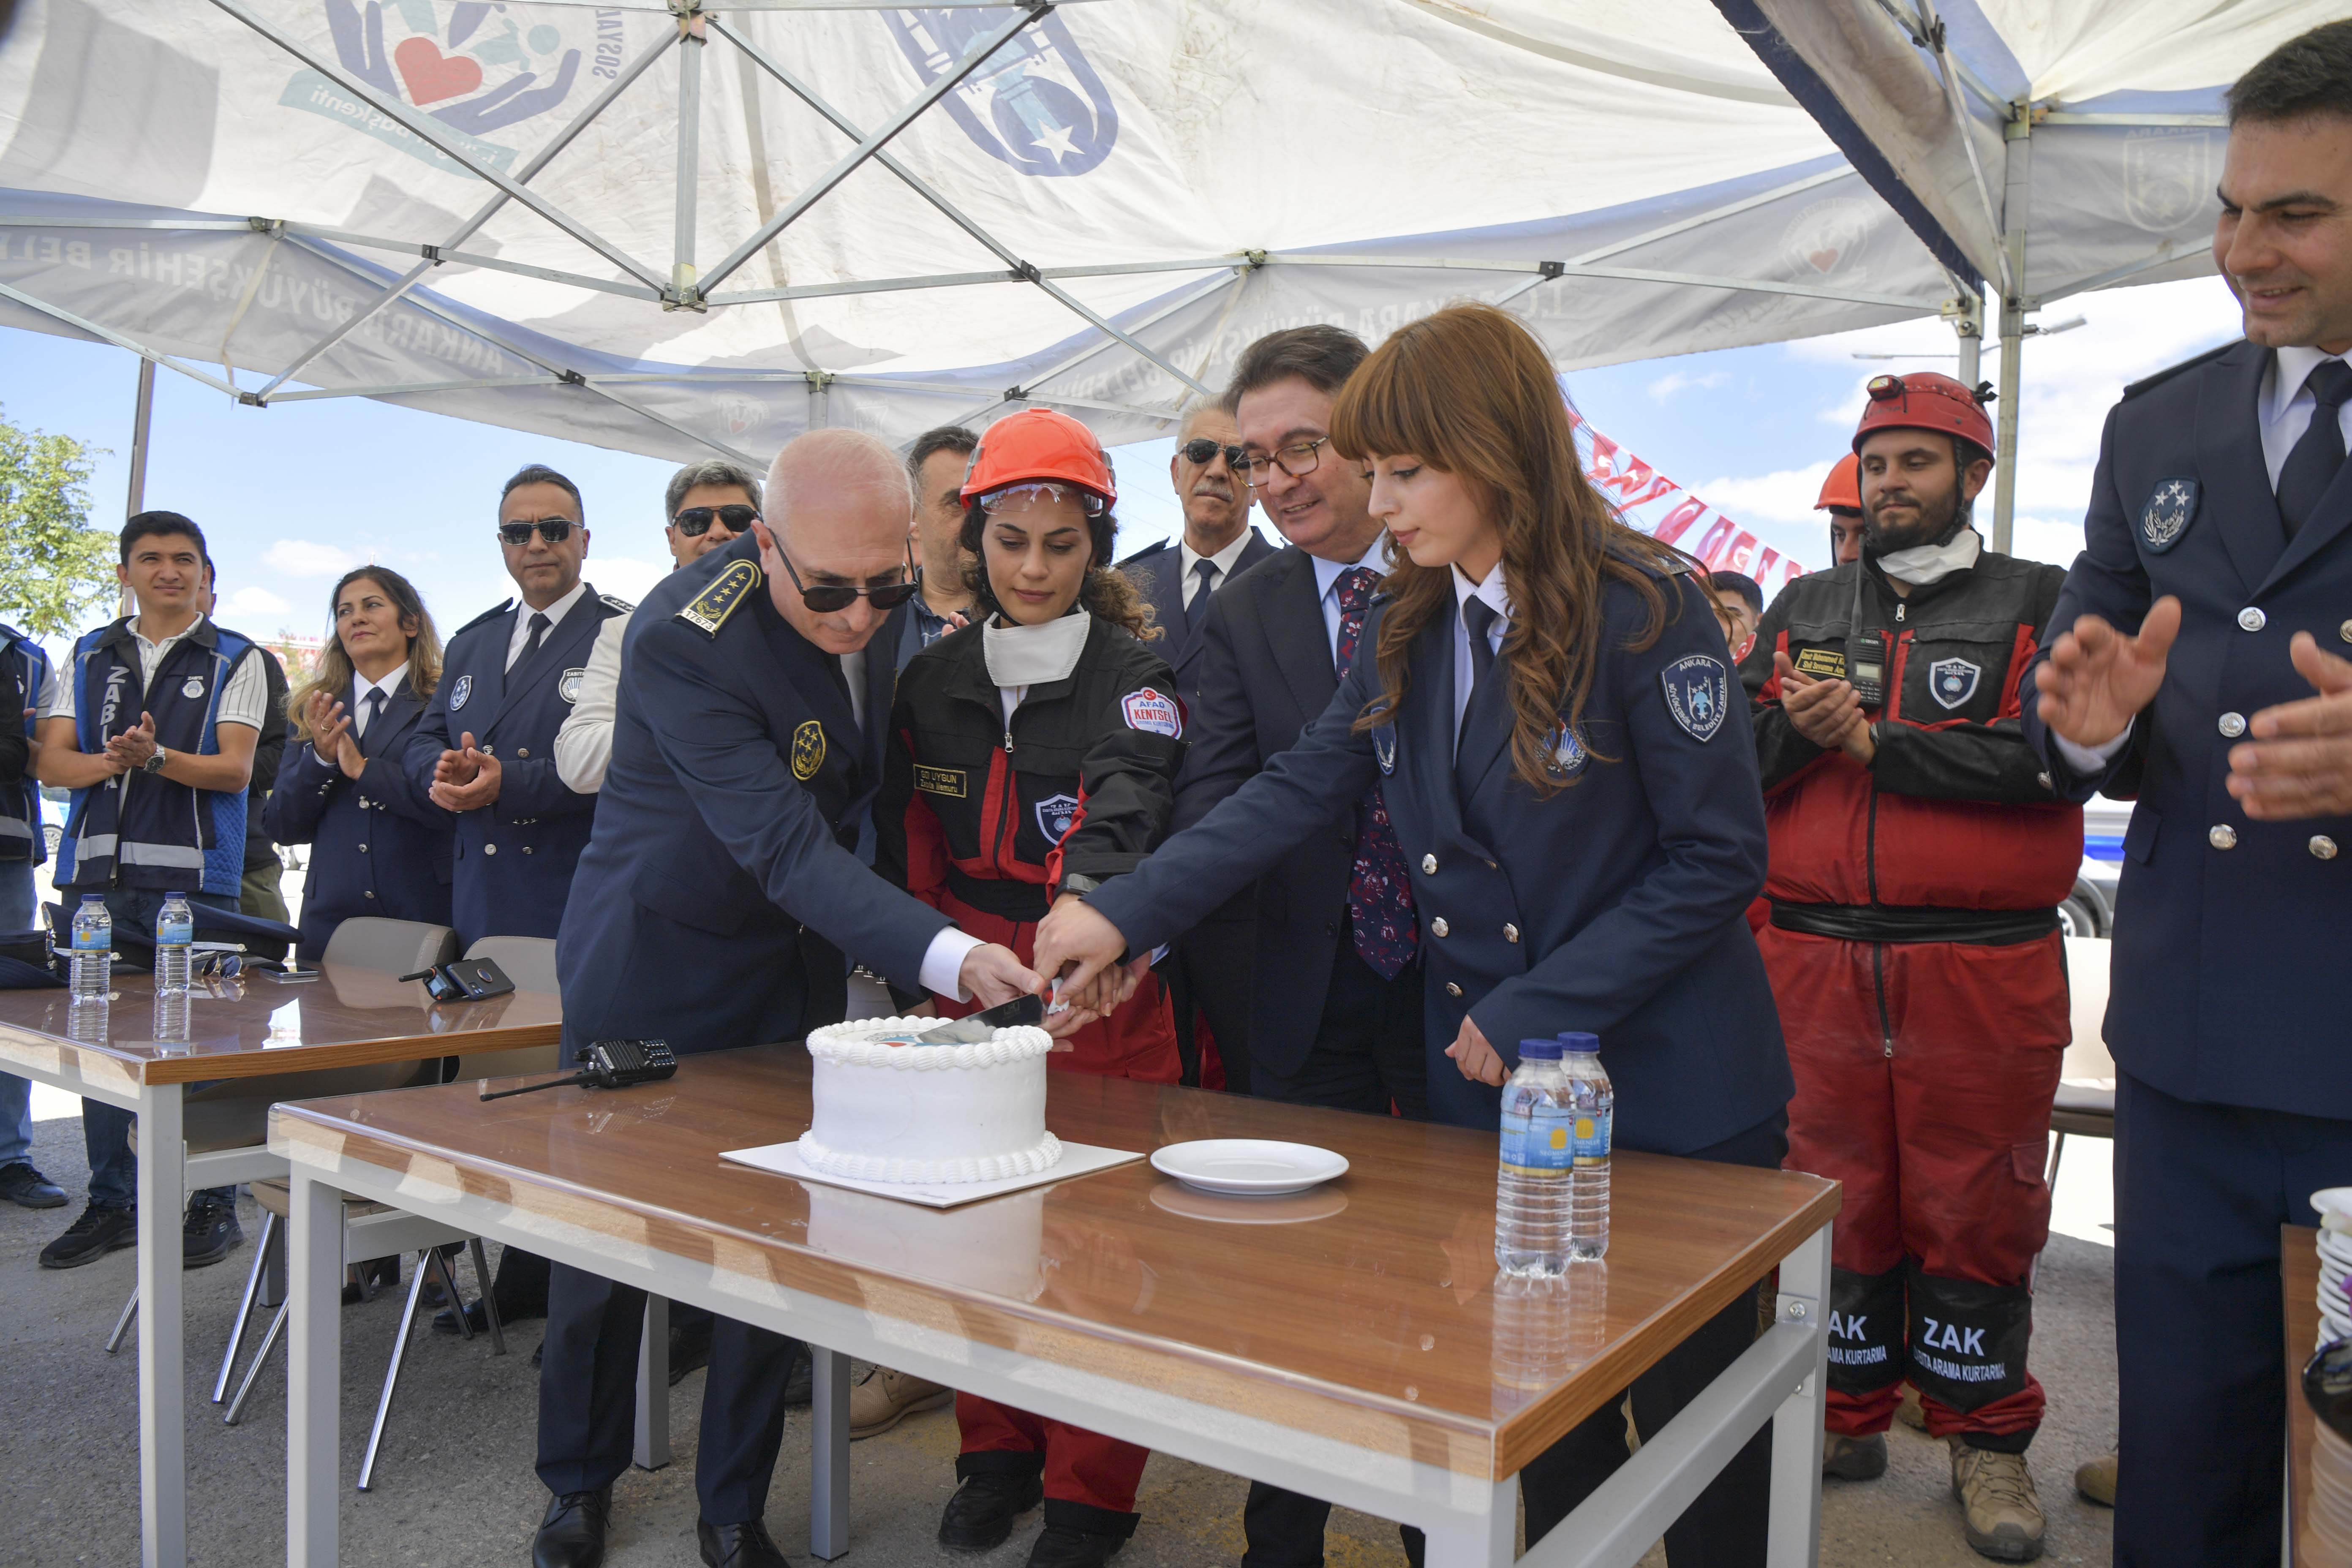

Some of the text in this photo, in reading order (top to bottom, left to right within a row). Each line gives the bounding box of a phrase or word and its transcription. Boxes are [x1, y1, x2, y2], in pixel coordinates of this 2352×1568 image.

[686, 611, 713, 629] 17673
[1679, 658, 1712, 672] ANKARA
[100, 666, 130, 791] ZABIA
[1133, 709, 1173, 727] KENTSEL
[932, 772, 957, 784] UYGUN
[1828, 1310, 1867, 1341] AK
[1923, 1316, 1985, 1357] ZAK
[1845, 1345, 1887, 1366] KURTARMA
[1931, 1356, 1961, 1380] ARAMA
[1962, 1362, 2006, 1383] KURTARMA
